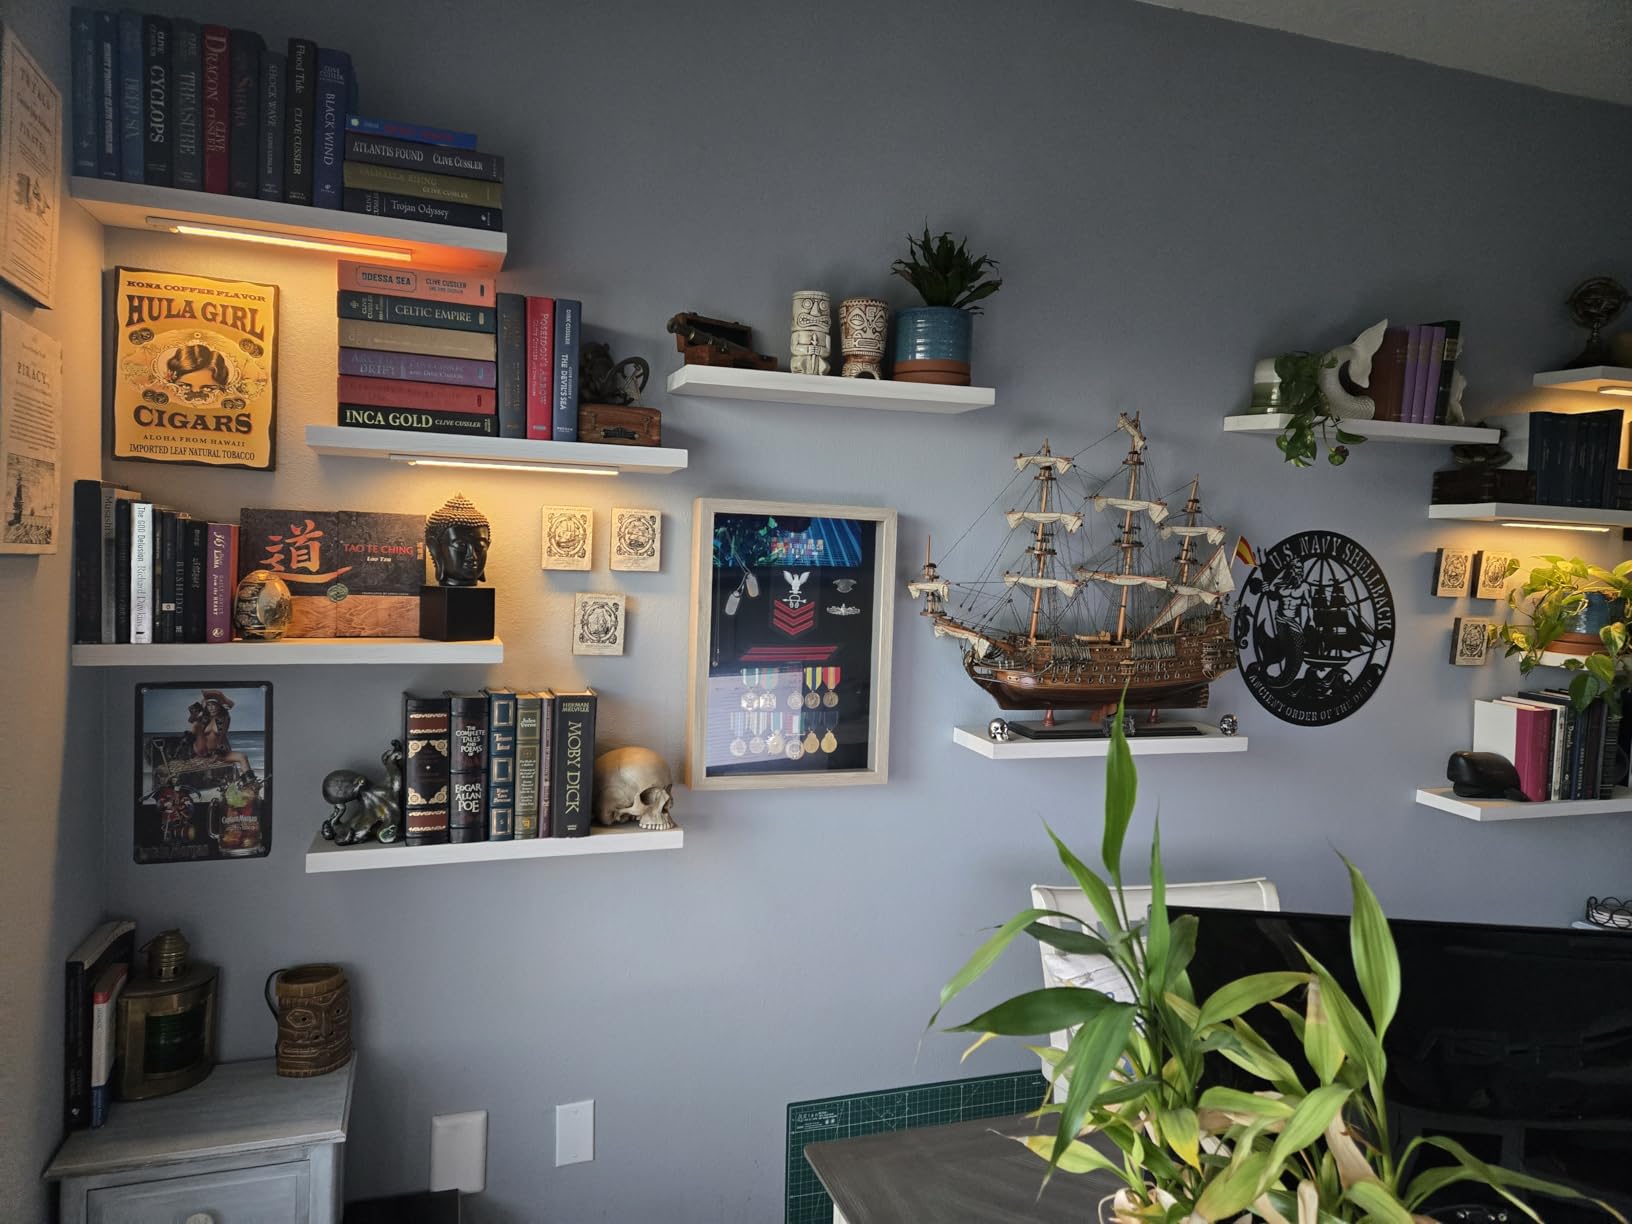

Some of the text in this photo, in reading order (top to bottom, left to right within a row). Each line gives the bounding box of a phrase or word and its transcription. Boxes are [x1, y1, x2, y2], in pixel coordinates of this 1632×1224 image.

[205, 34, 228, 101] DRAGON
[265, 64, 278, 101] SHOCK
[149, 65, 166, 144] CYCLOPS
[177, 72, 197, 155] TREASURE
[265, 101, 278, 128] WAVE
[291, 44, 306, 176] Flood Tide CLIVE CUSSLER
[215, 120, 226, 153] CLIVE
[321, 92, 337, 167] BLACK WIND
[352, 141, 484, 171] ATLANTIS FOUND CLIVE CUSSLER
[390, 199, 450, 222] Trojan Odyssey
[126, 281, 267, 303] KONA COFFEE FLAVOR
[361, 271, 412, 286] ODESSA SEA
[425, 278, 468, 289] CLIVE CUSSLER
[125, 295, 265, 343] HULA GIRL
[394, 303, 434, 317] CELTIC
[434, 310, 473, 323] EMPIRE
[564, 309, 573, 345] DIRK CUSSLER
[539, 313, 550, 367] POSEIDON'S
[559, 353, 569, 410] THE DEVIL'S SEA
[133, 405, 253, 435] CIGARS
[345, 409, 480, 429] INCA GOLD CLIVE CUSSLER
[129, 443, 256, 462] IMPORTED LEAF NATURAL TOBACCO
[143, 434, 176, 443] ALOHA
[179, 437, 208, 445] FROM
[103, 495, 115, 537] Musashi's
[258, 519, 353, 584] 道
[344, 543, 365, 554] TAO
[367, 543, 380, 554] TE
[381, 545, 414, 556] CHING
[134, 507, 147, 627] The GOD Delusion Richard Dawkins
[1268, 534, 1393, 631] U.S. NAVY SHELLBACK
[175, 561, 185, 615] BUSHIDO
[1248, 673, 1285, 713] ANCIENT
[1285, 705, 1319, 722] ORDER
[1319, 709, 1333, 721] OF
[1333, 699, 1354, 717] THE
[455, 730, 486, 738] COMPLETE
[460, 744, 483, 755] POEMS
[462, 735, 481, 745] TALES
[565, 720, 583, 815] MOBY DICK
[455, 783, 482, 794] EDGAR
[455, 793, 481, 802] ALLAN
[457, 800, 480, 813] POE
